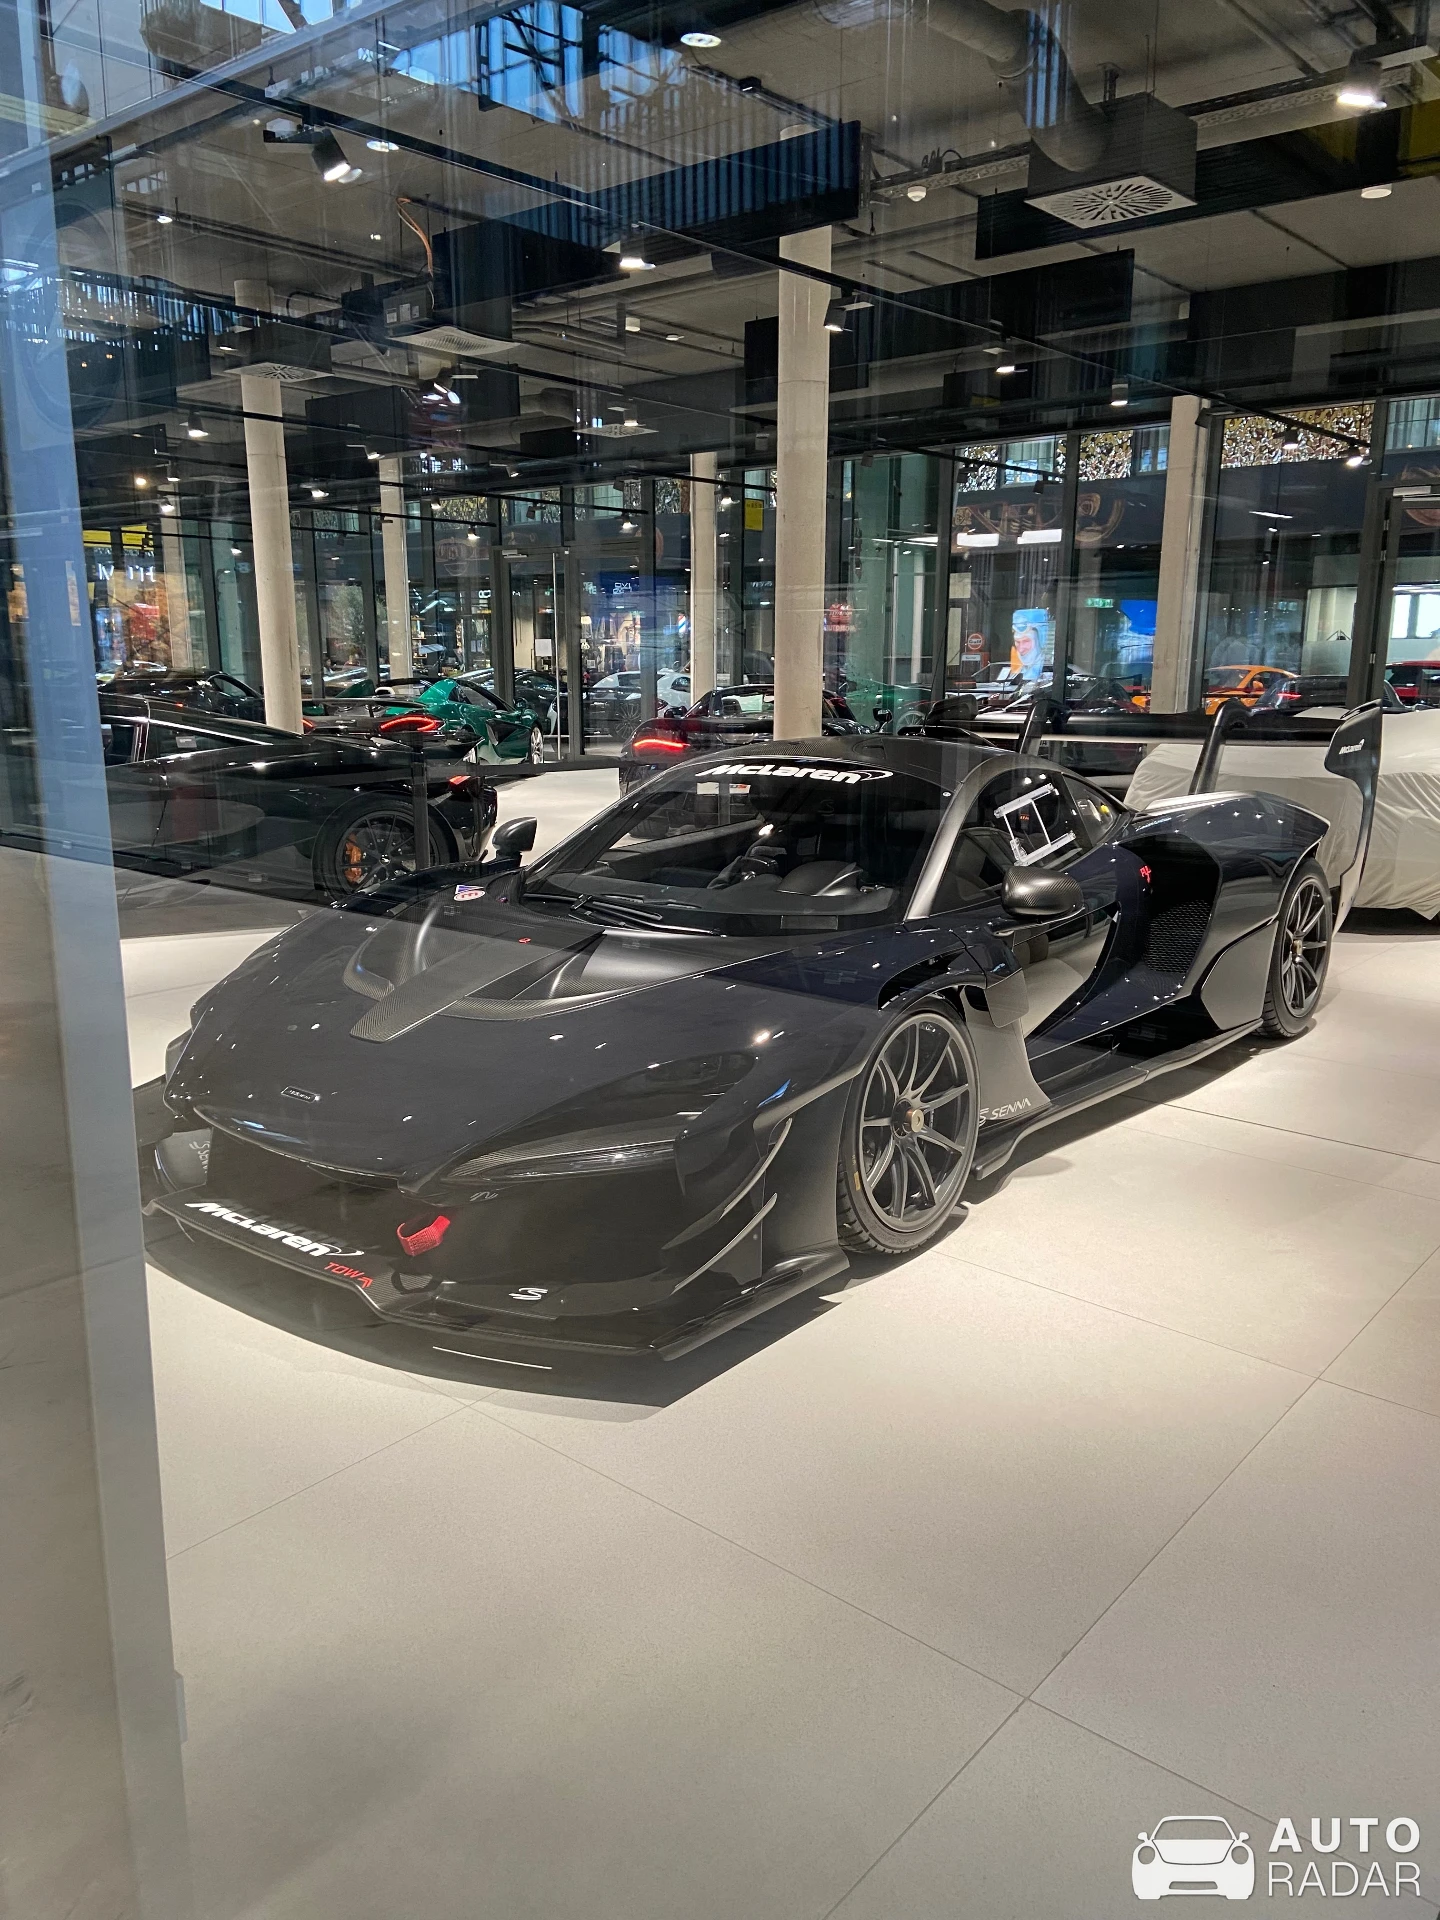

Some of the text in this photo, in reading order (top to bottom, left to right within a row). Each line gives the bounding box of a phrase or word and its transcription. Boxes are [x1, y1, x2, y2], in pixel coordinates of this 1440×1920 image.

[694, 764, 866, 785] McLaren
[990, 1097, 1031, 1120] SENNA
[184, 1202, 336, 1257] McLaren
[324, 1261, 364, 1278] TOW
